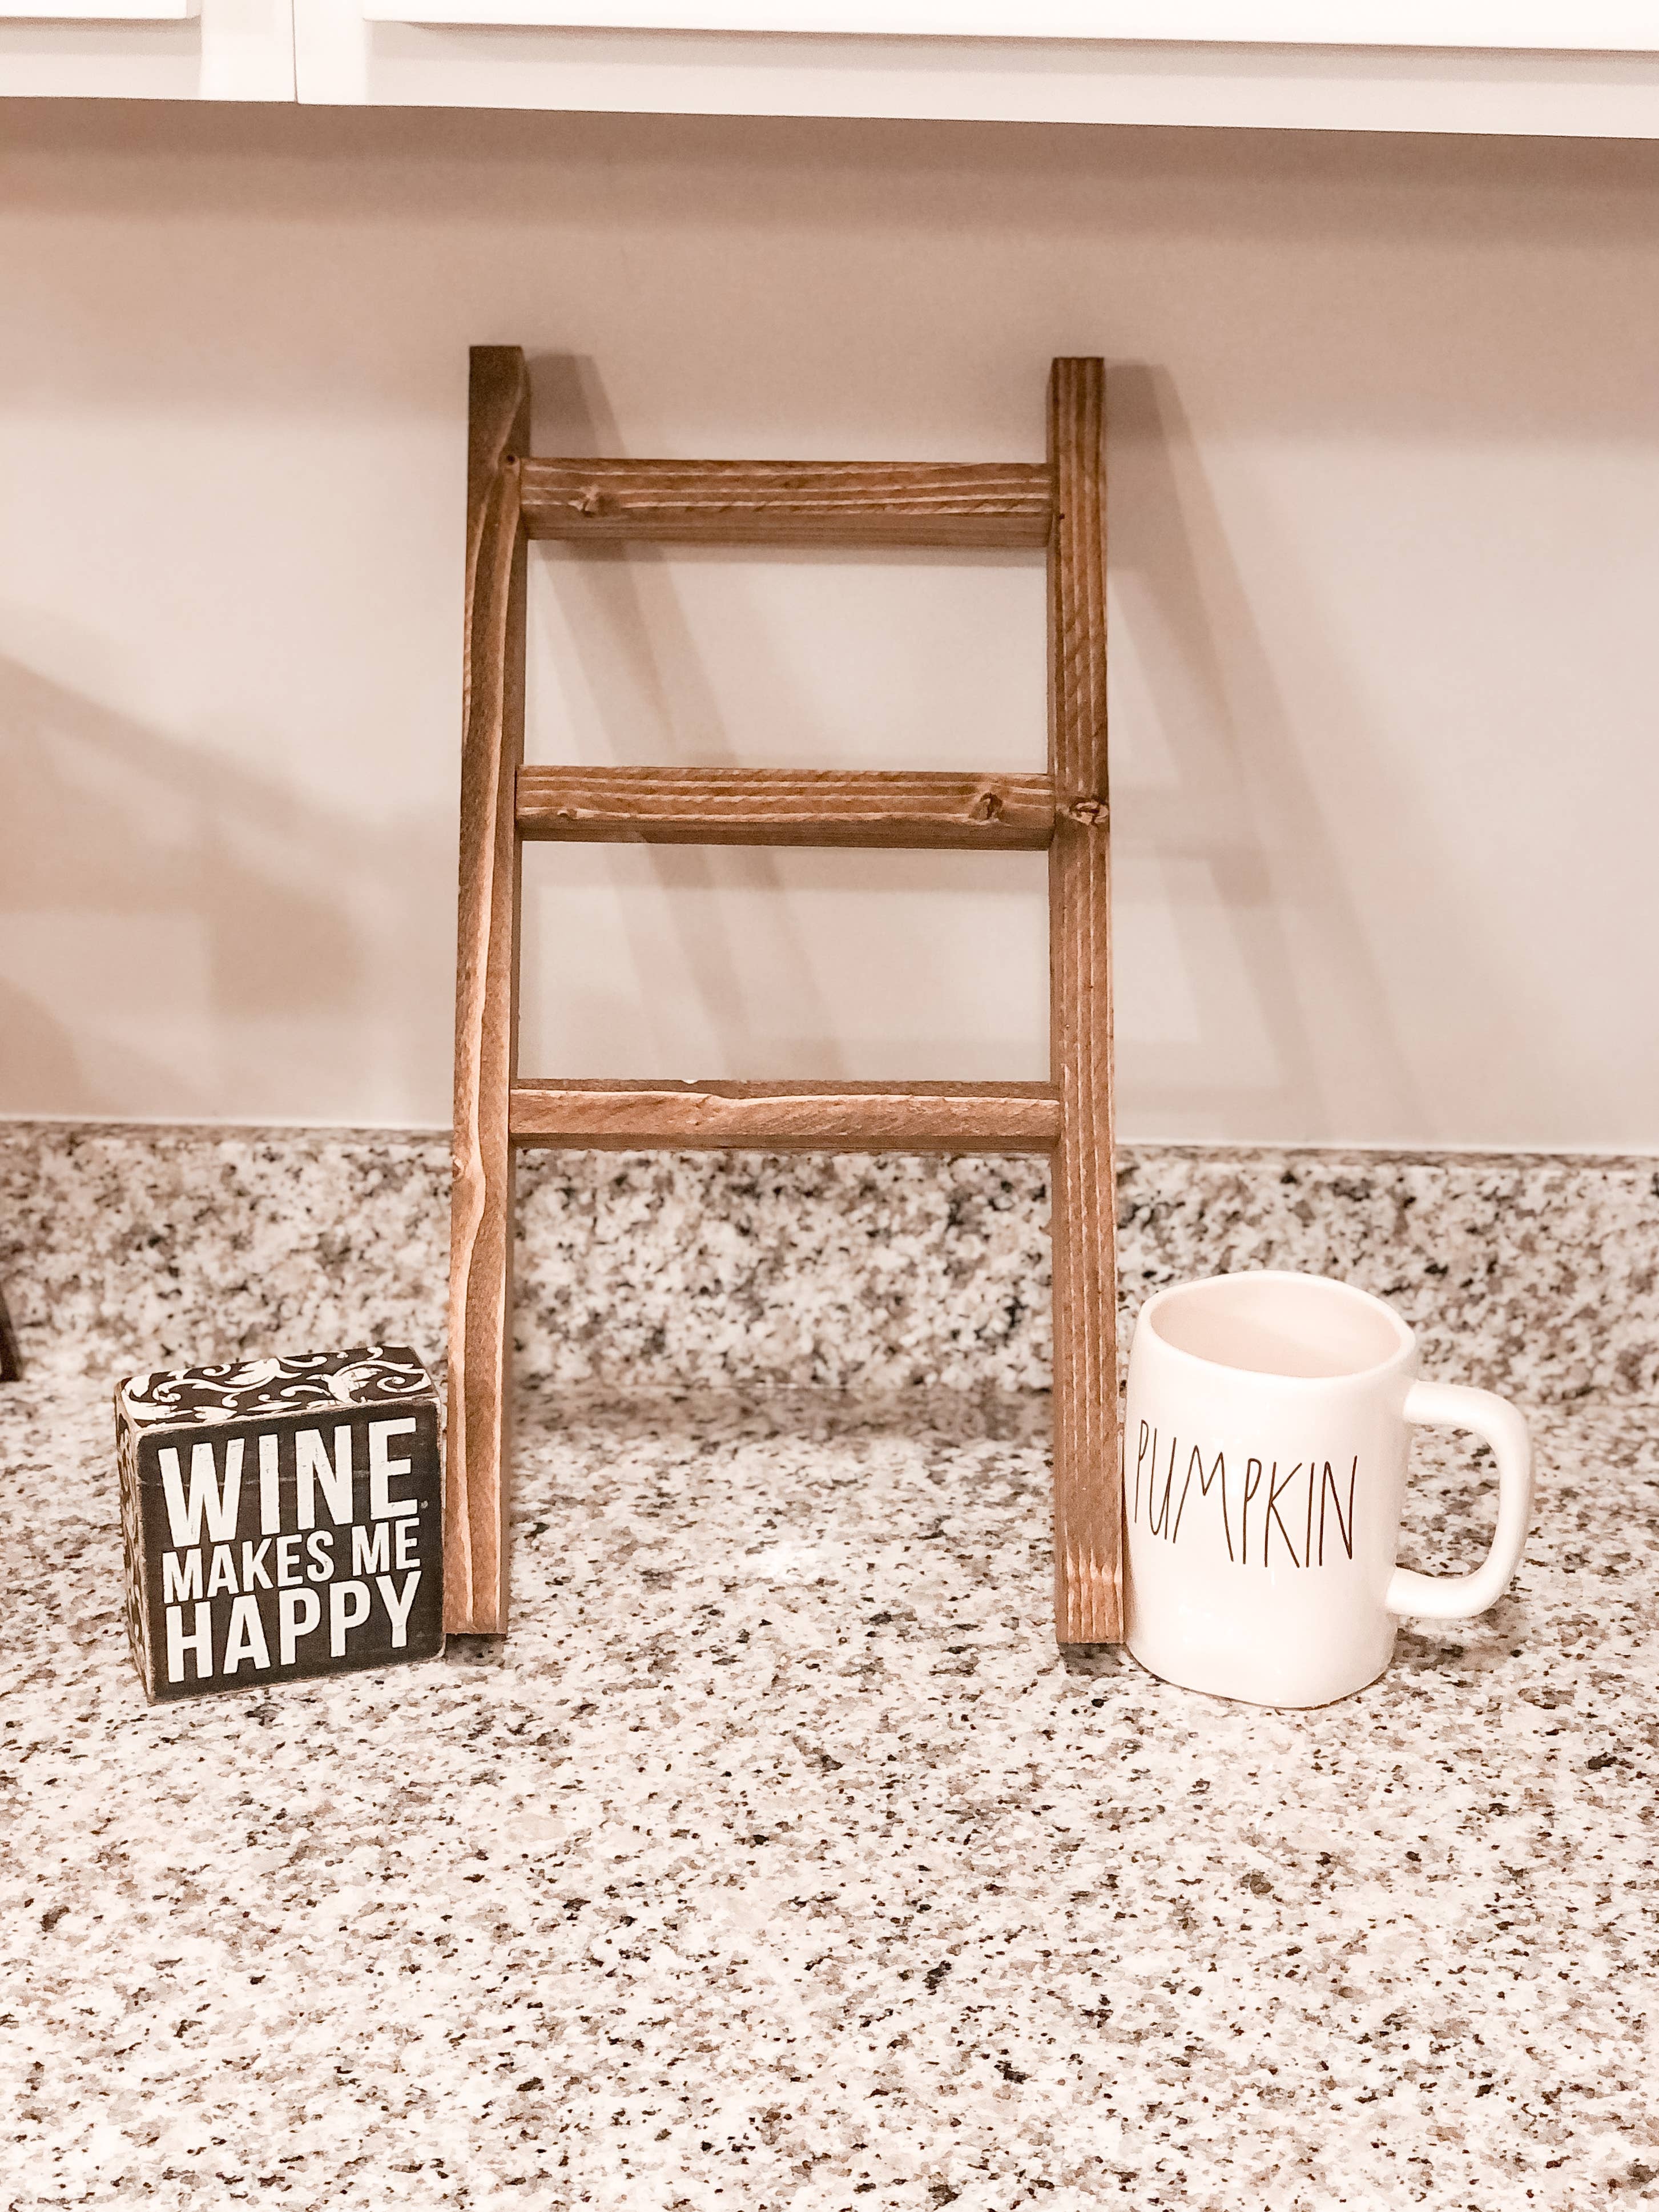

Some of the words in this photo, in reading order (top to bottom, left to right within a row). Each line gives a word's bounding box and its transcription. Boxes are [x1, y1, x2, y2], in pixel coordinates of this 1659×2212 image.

[158, 1417, 418, 1548] WINE
[1134, 1419, 1358, 1568] PUMPKIN
[162, 1529, 334, 1604] MAKES
[351, 1517, 421, 1576] ME
[166, 1570, 422, 1683] HAPPY
